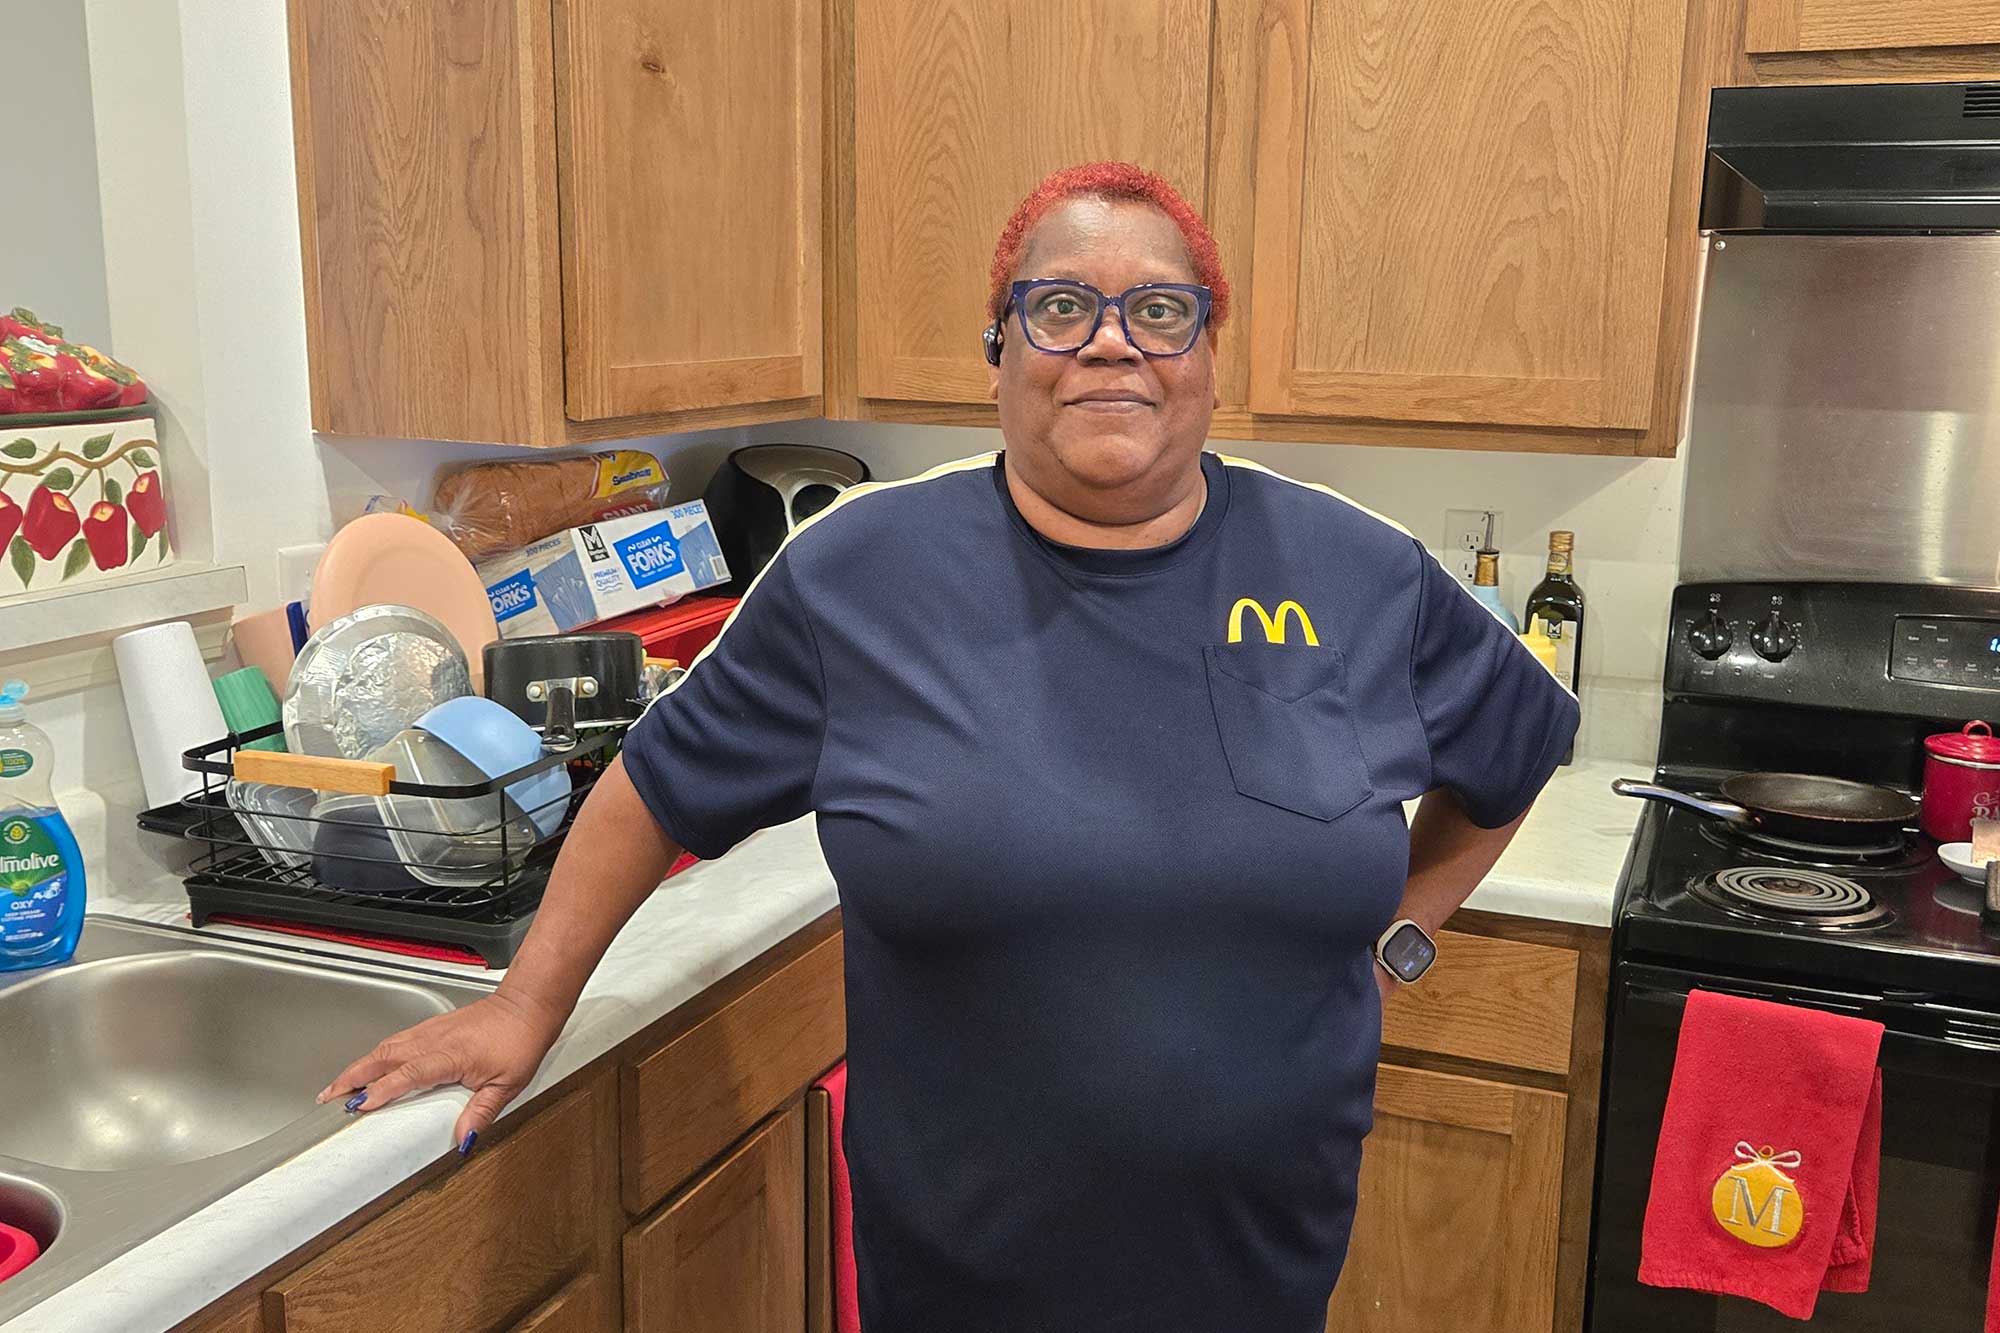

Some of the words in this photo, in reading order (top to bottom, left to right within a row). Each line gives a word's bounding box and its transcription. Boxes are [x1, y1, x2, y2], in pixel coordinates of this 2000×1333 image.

[627, 542, 676, 575] FORKS
[491, 585, 531, 612] ORKS
[0, 852, 59, 873] lmolive
[11, 900, 33, 910] OXY
[1721, 1175, 1793, 1238] M
